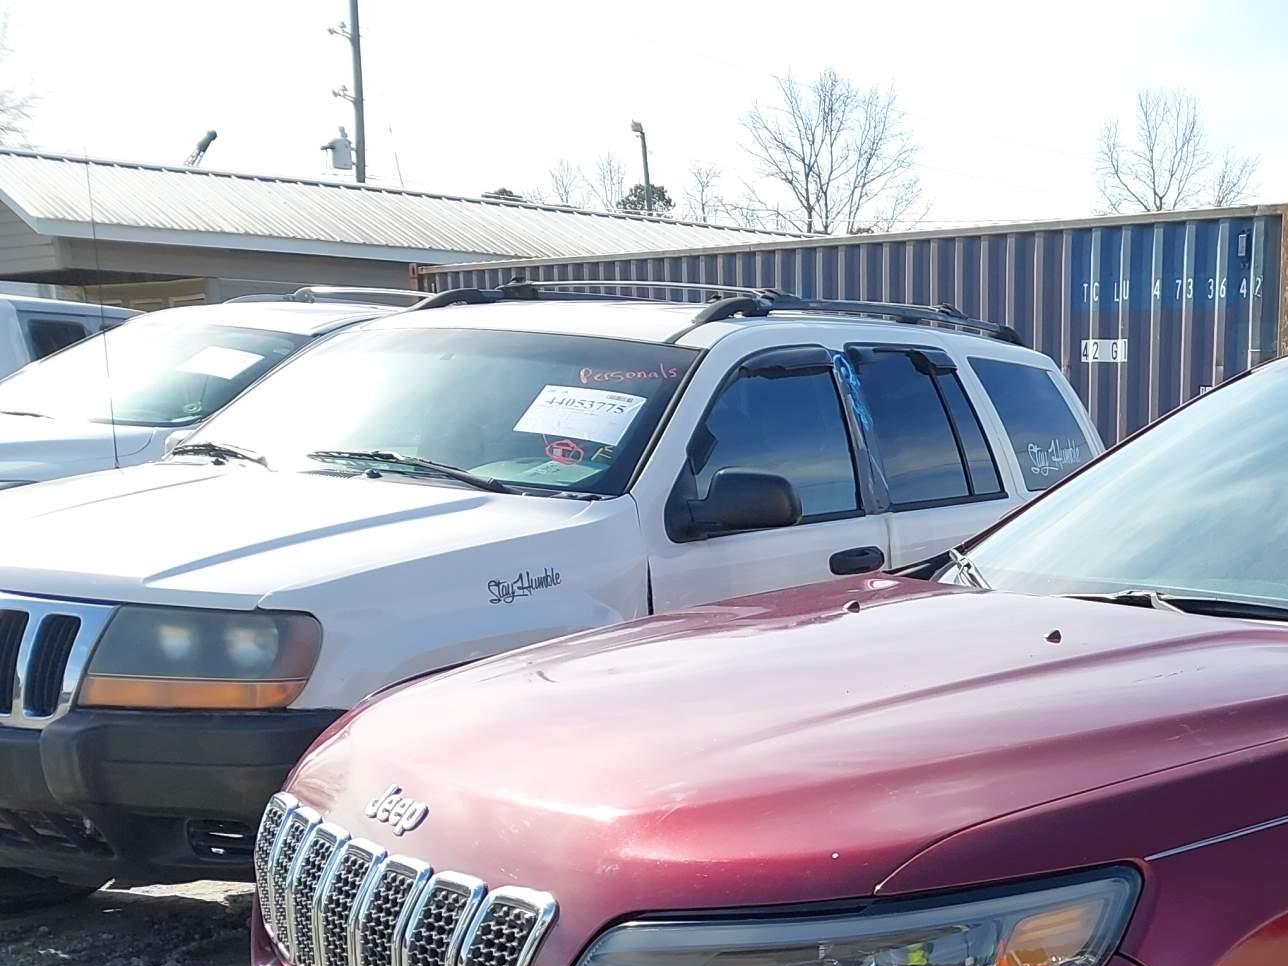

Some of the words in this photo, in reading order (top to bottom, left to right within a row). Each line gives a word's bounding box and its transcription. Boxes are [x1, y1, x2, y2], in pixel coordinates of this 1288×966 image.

[579, 363, 677, 384] Personals
[545, 396, 626, 415] 44053775
[488, 580, 528, 604] Stay
[513, 567, 561, 595] Humble
[366, 783, 429, 837] Jeep
